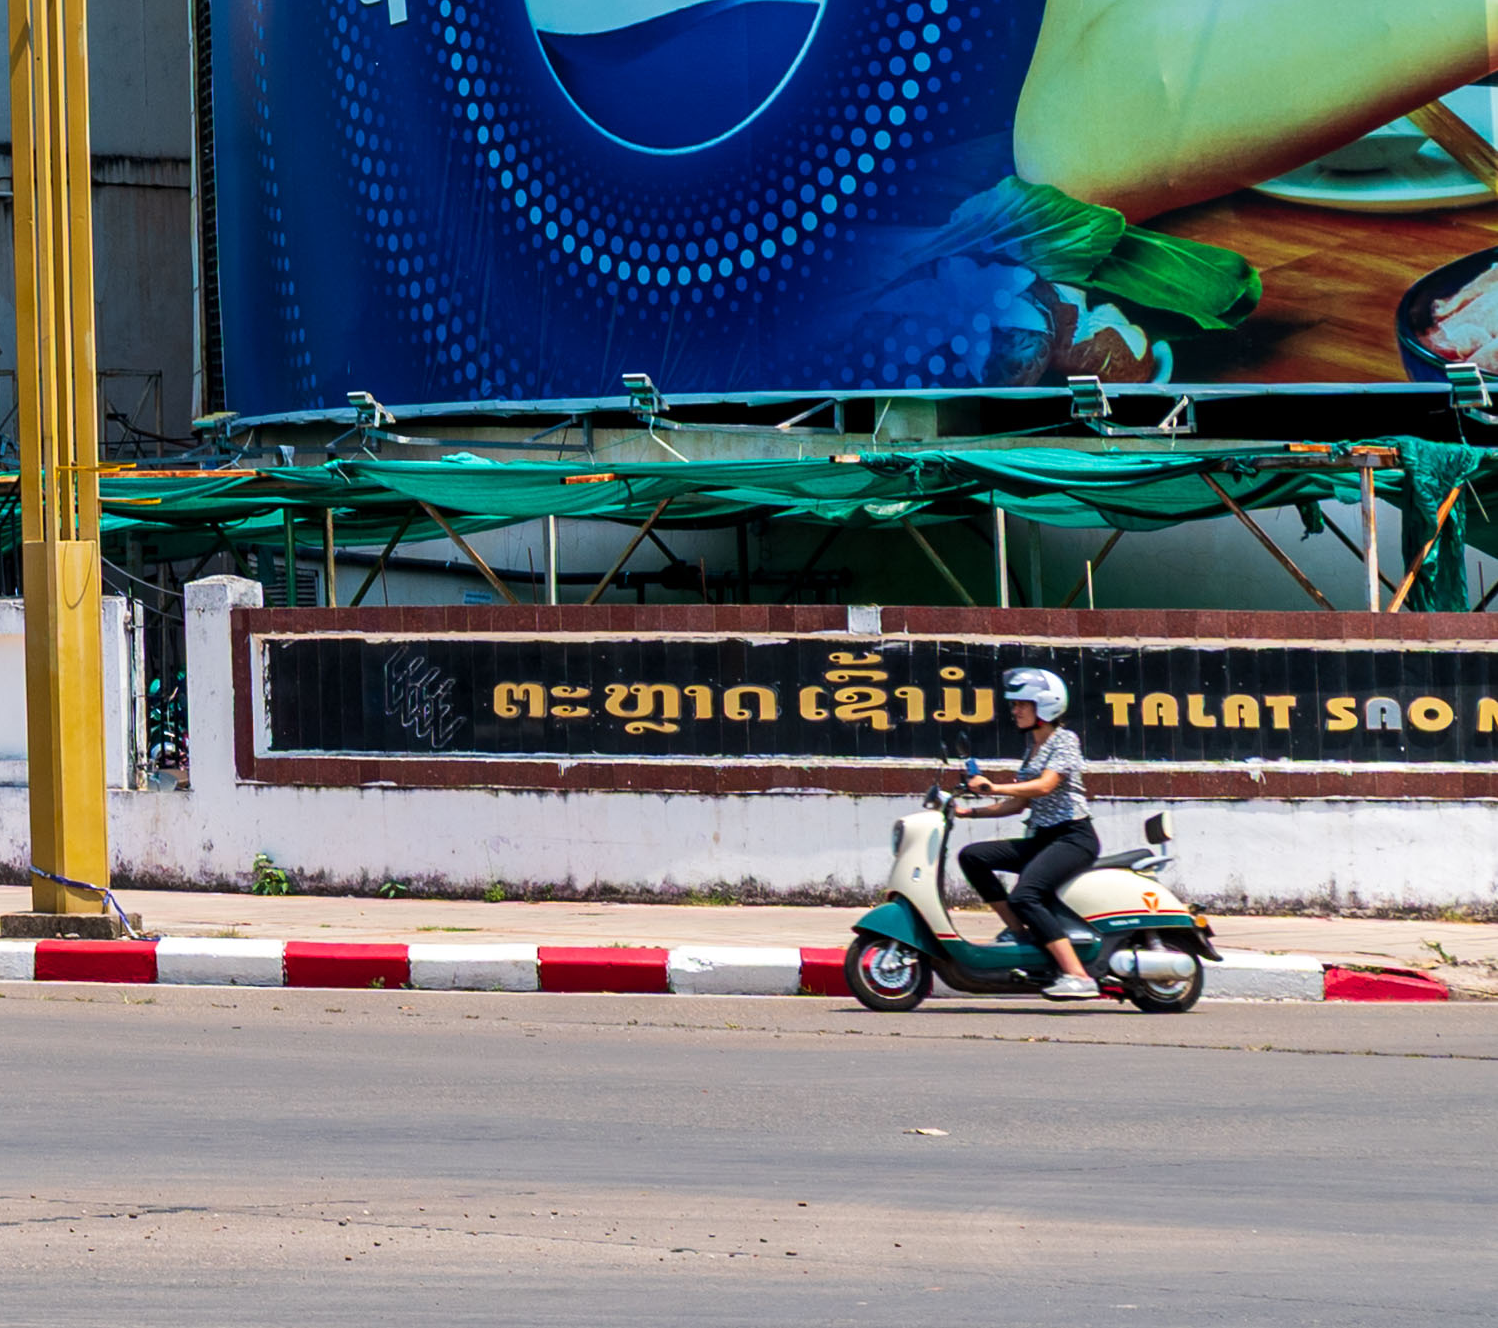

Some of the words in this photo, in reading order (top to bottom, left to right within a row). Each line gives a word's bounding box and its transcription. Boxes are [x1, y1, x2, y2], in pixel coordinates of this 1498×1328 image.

[492, 680, 779, 735] ຕະຫຼາດ
[1104, 692, 1297, 730] TALAT
[1326, 696, 1454, 732] SAO
